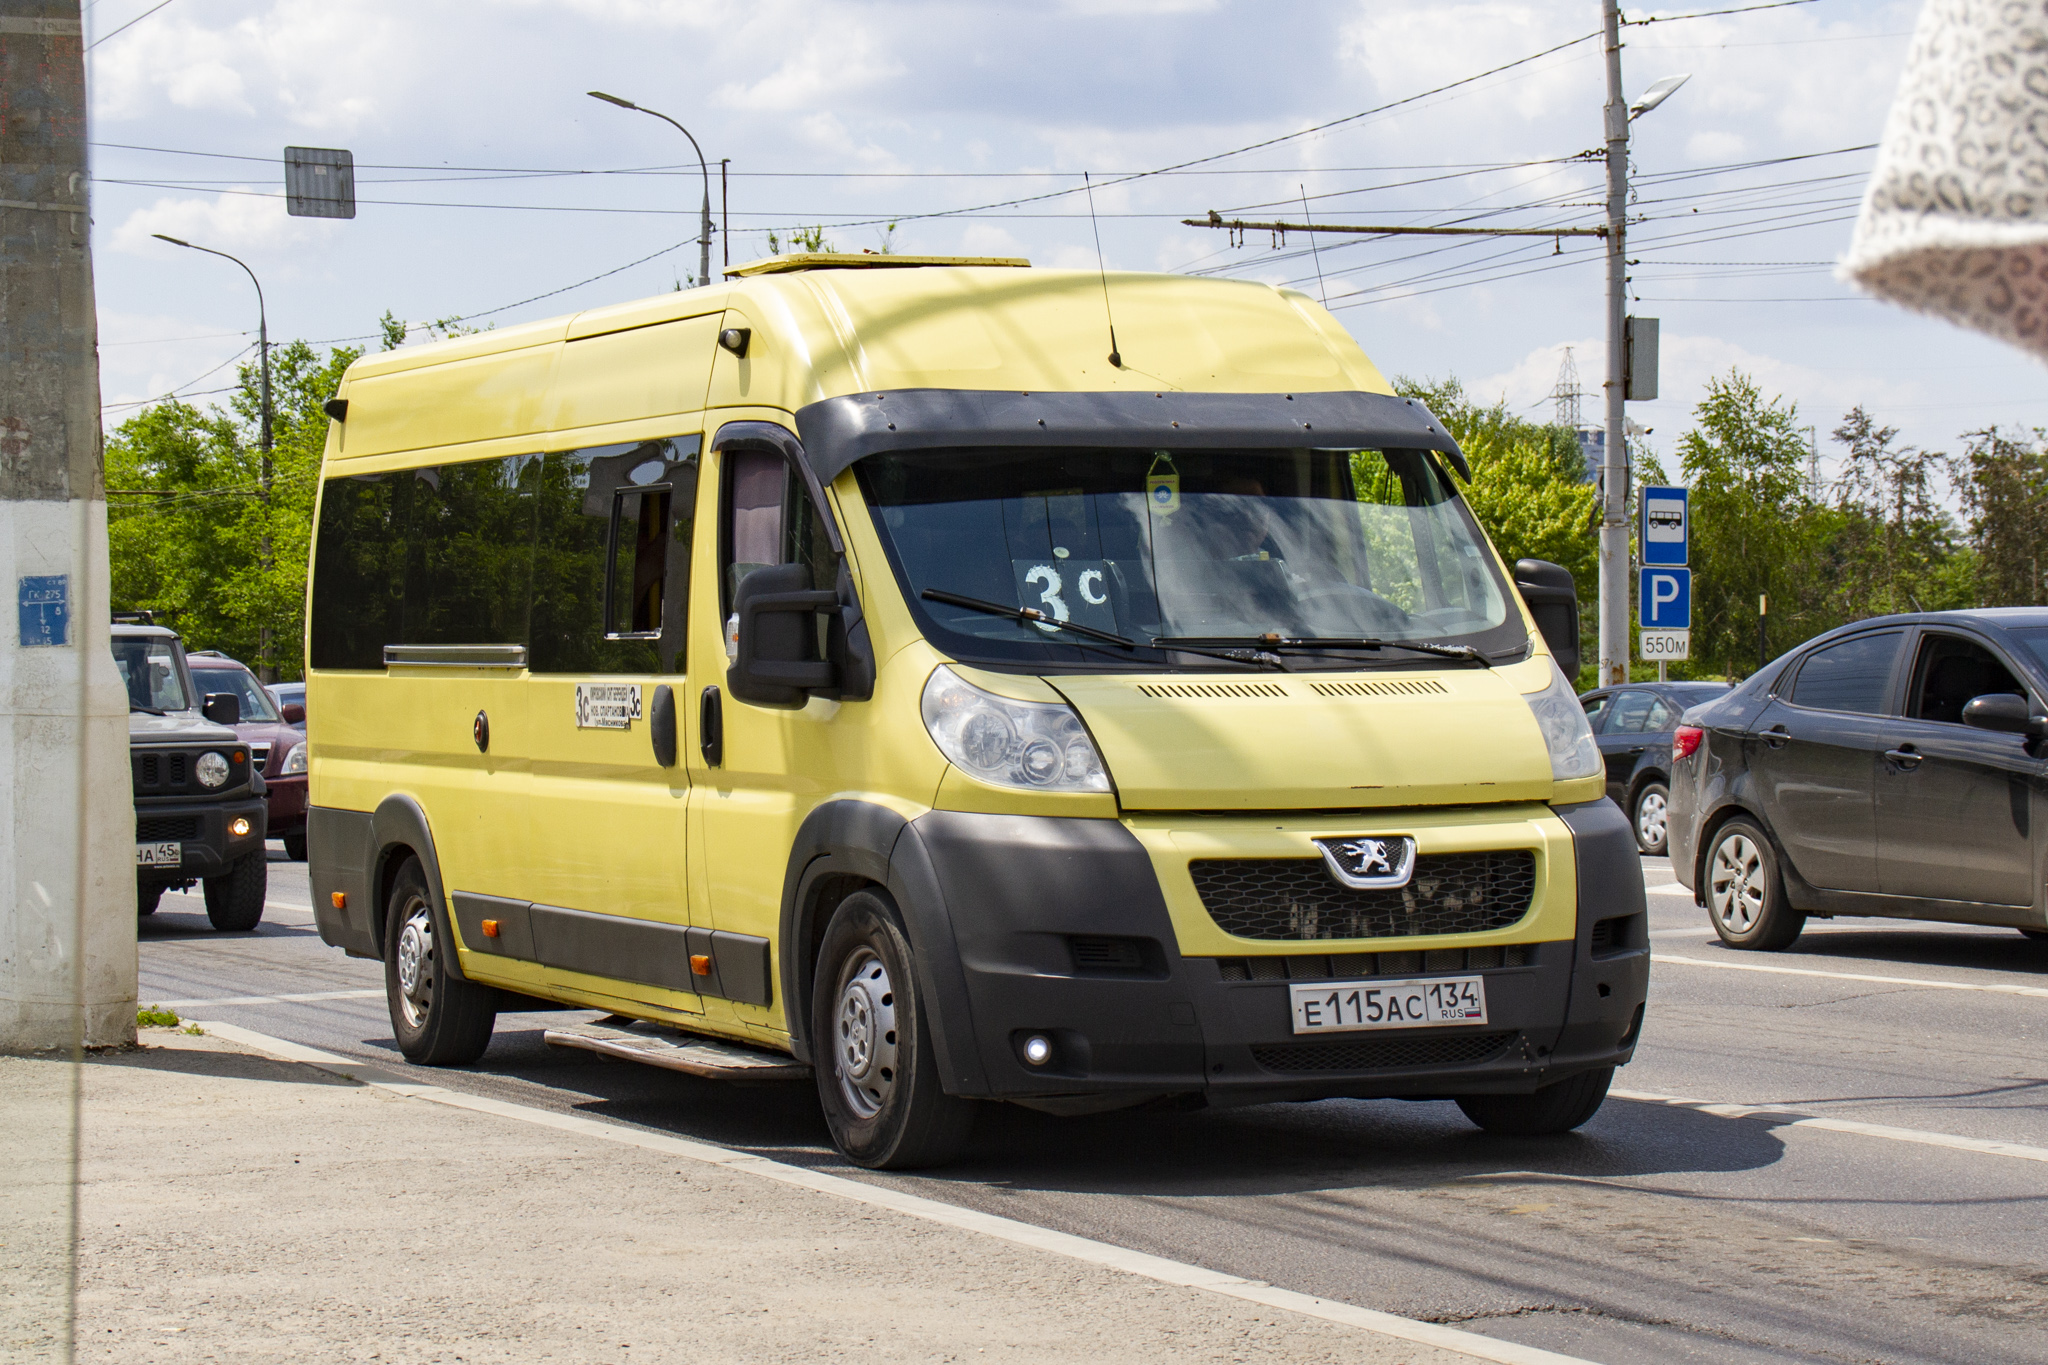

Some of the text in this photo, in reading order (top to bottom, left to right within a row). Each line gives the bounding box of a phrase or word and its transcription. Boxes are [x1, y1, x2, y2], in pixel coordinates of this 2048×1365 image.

[45, 589, 61, 599] 275
[1652, 575, 1680, 621] P
[40, 625, 51, 634] 12
[158, 844, 175, 857] 45
[1429, 982, 1475, 1009] 134
[1442, 1008, 1464, 1019] RUS
